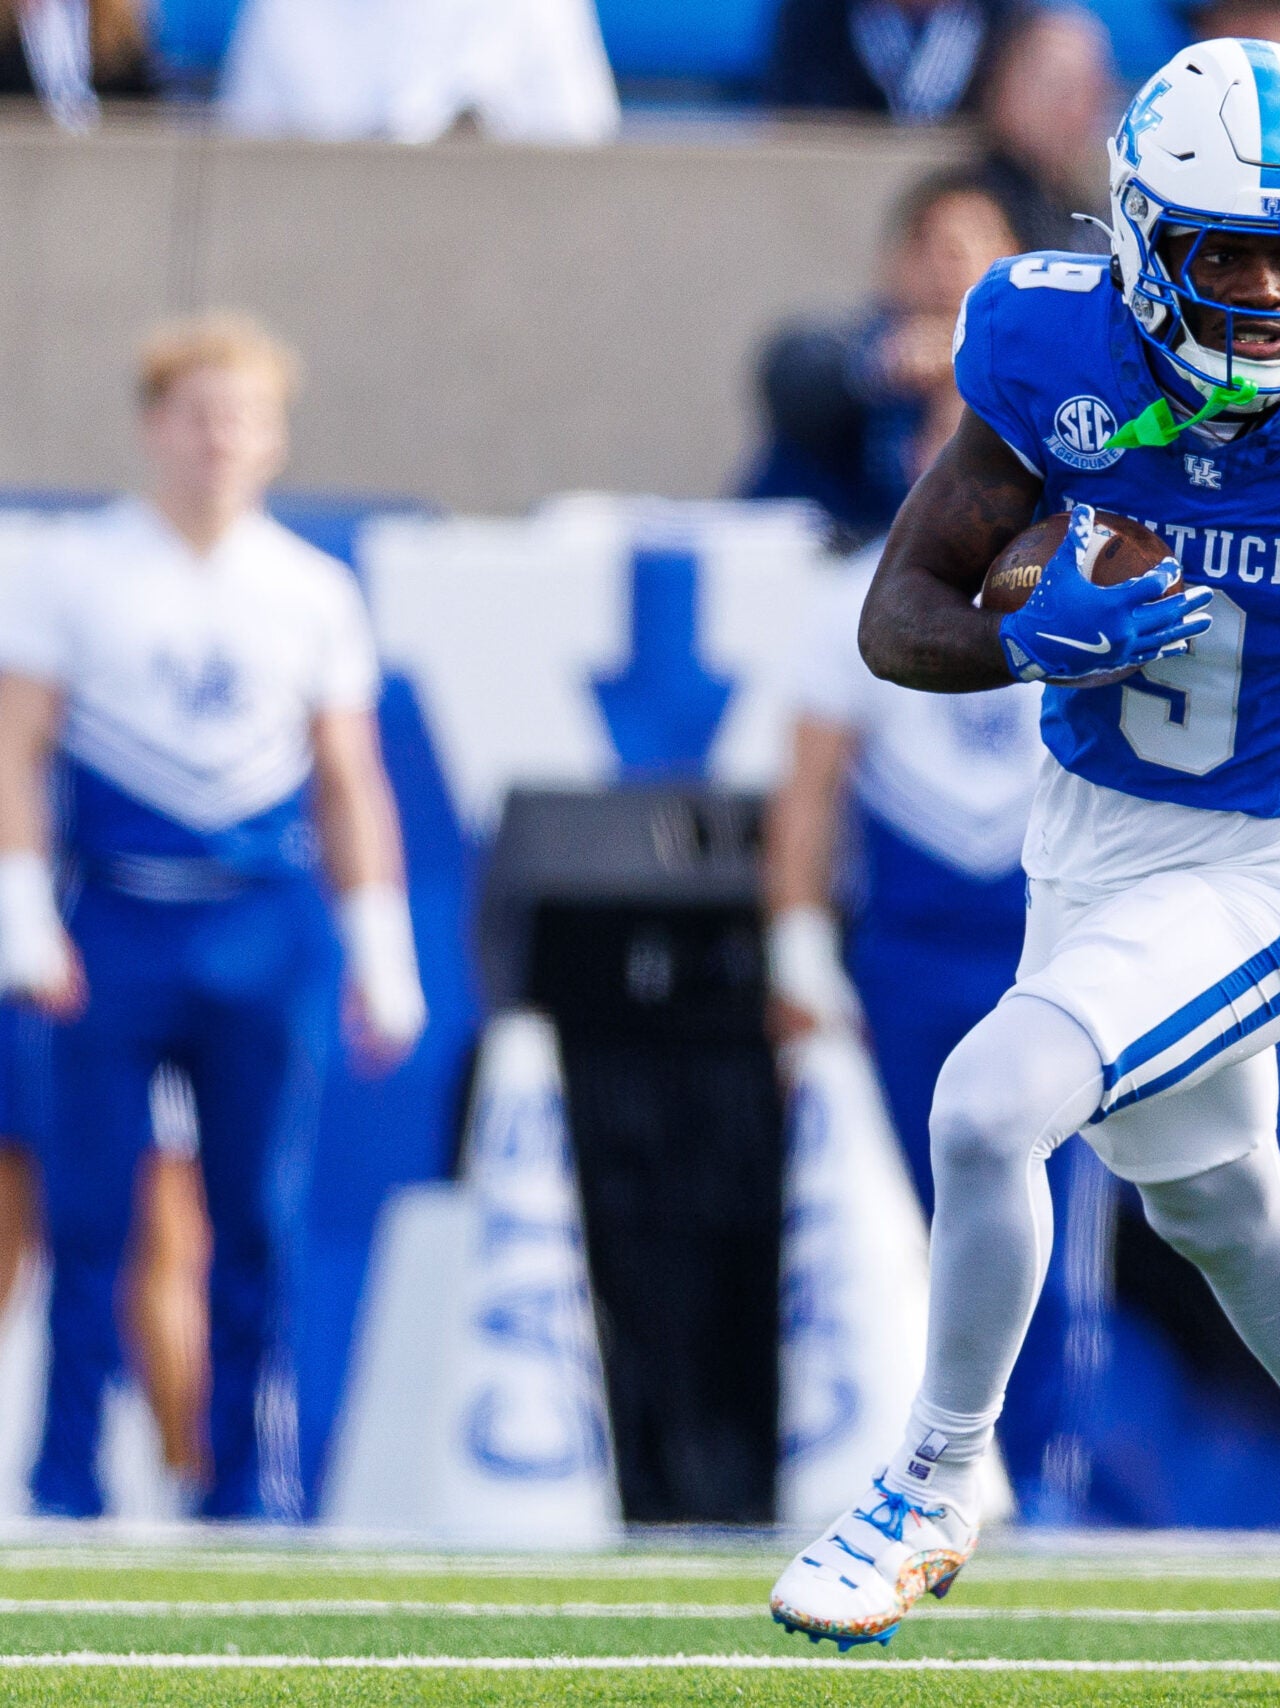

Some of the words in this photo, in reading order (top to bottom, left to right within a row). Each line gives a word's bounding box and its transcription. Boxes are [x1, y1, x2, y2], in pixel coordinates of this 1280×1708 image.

[1009, 258, 1102, 292] 9
[1059, 400, 1111, 451] SEC
[1056, 445, 1121, 469] GRADUATE
[1184, 454, 1221, 490] UK
[991, 565, 1042, 590] Wilson
[1119, 583, 1247, 776] 9
